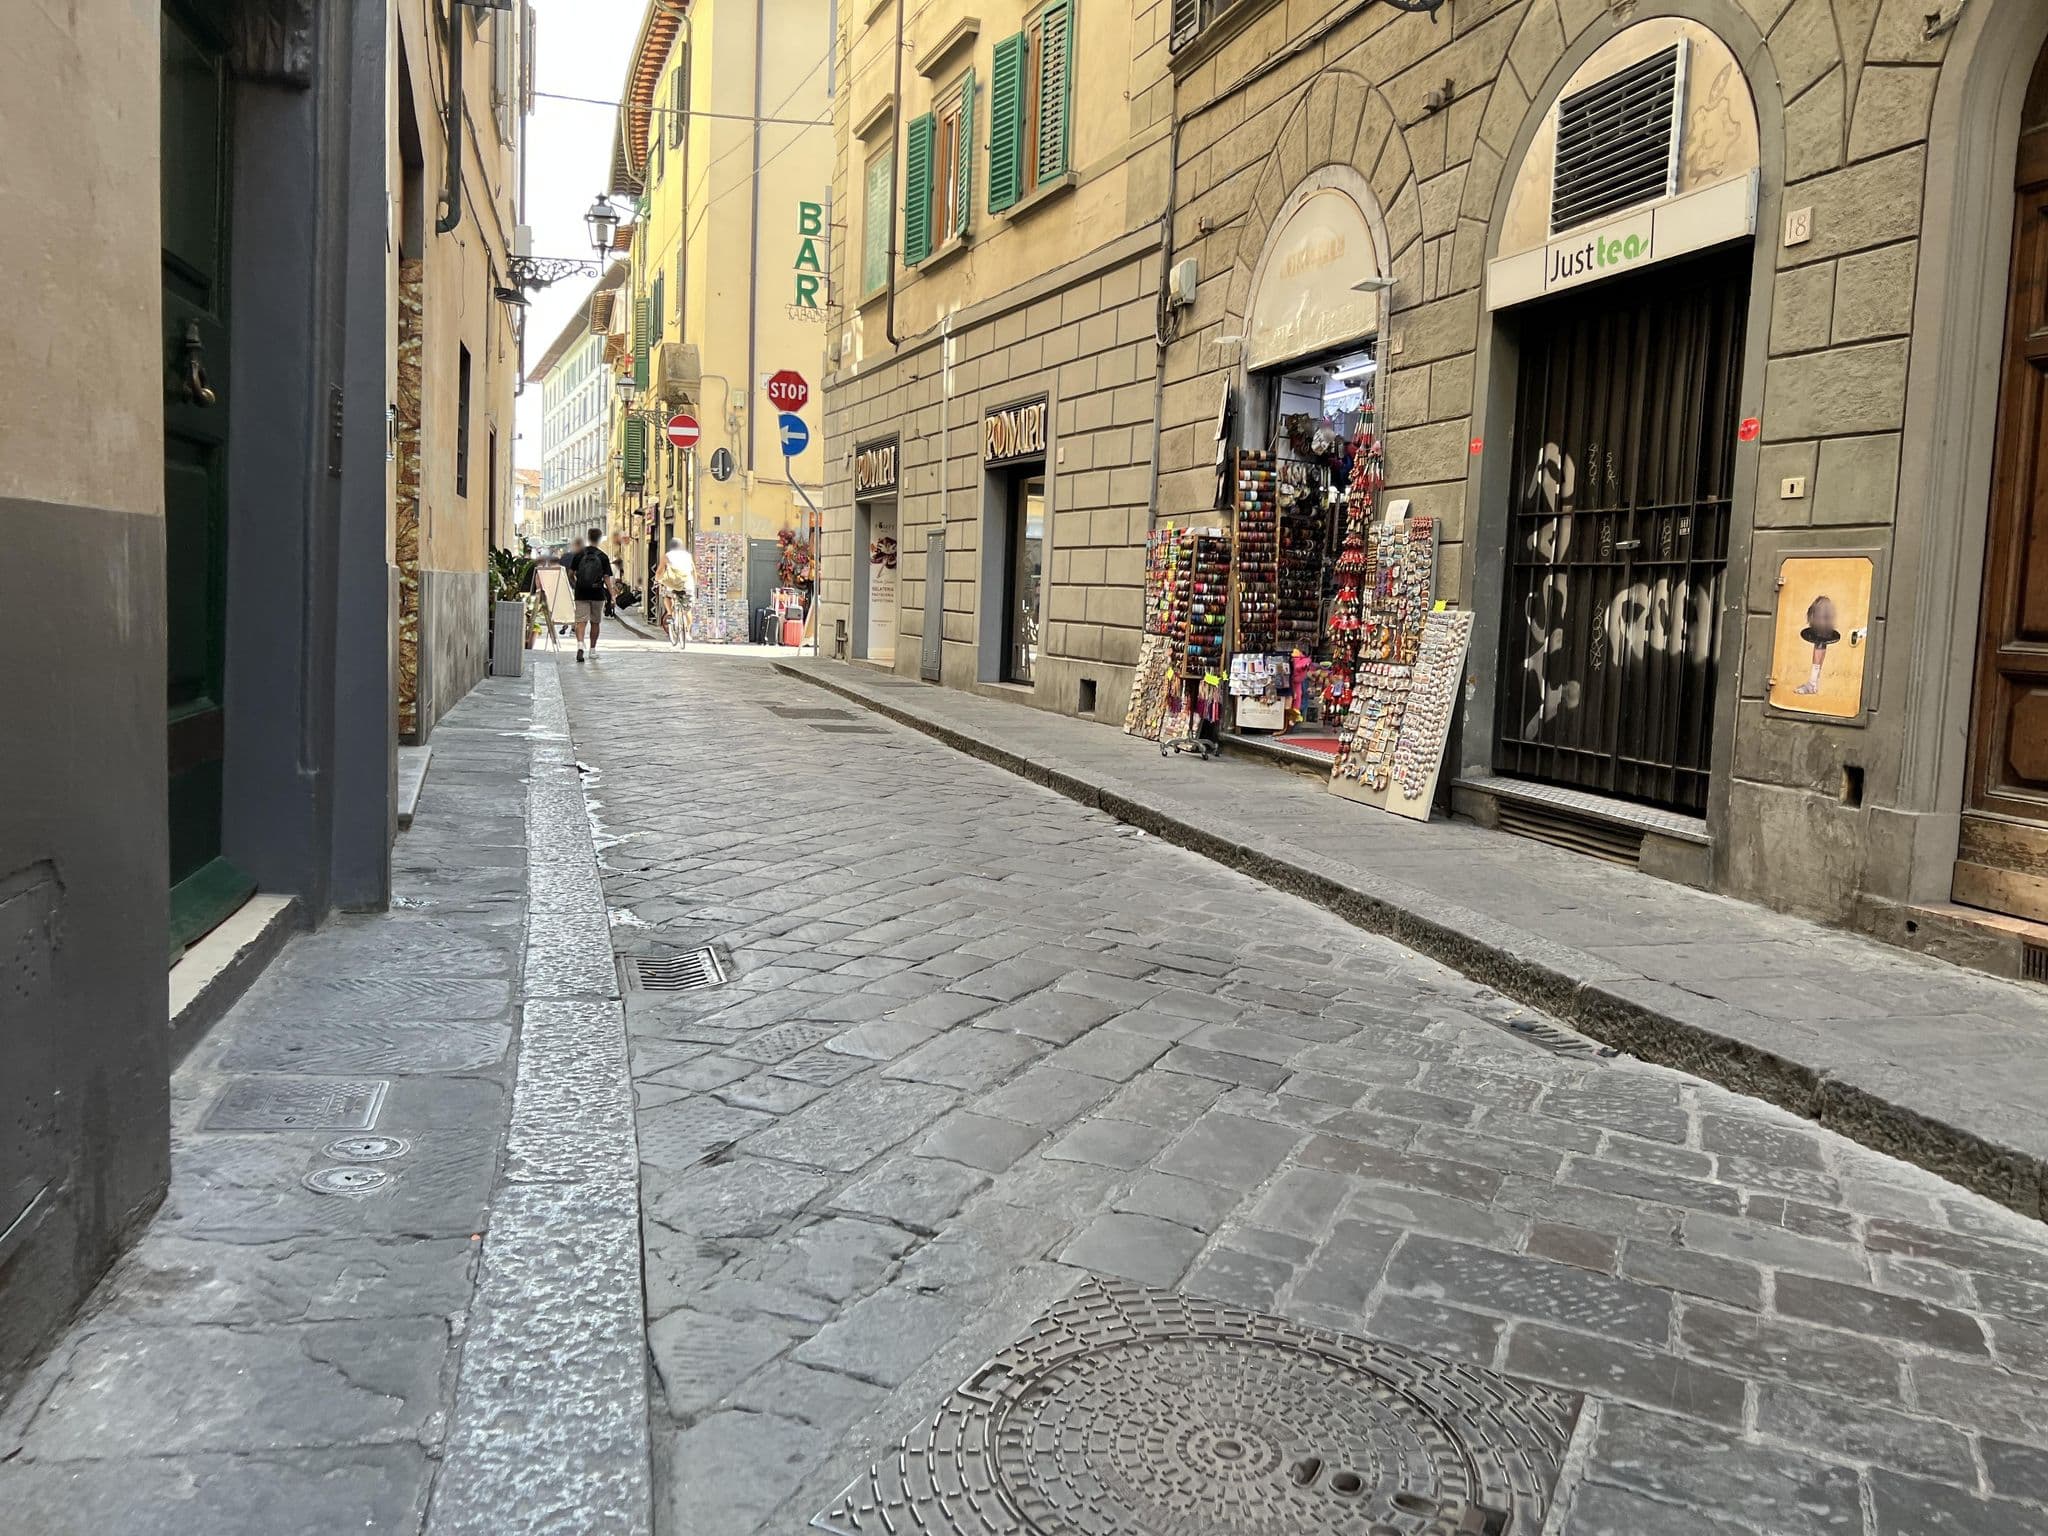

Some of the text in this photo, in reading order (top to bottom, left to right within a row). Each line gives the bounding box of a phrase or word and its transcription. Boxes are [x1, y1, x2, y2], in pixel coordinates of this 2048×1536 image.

[1789, 215, 1807, 239] 18
[794, 201, 822, 308] BAR
[1550, 233, 1649, 282] Just tea
[770, 382, 807, 401] STOP
